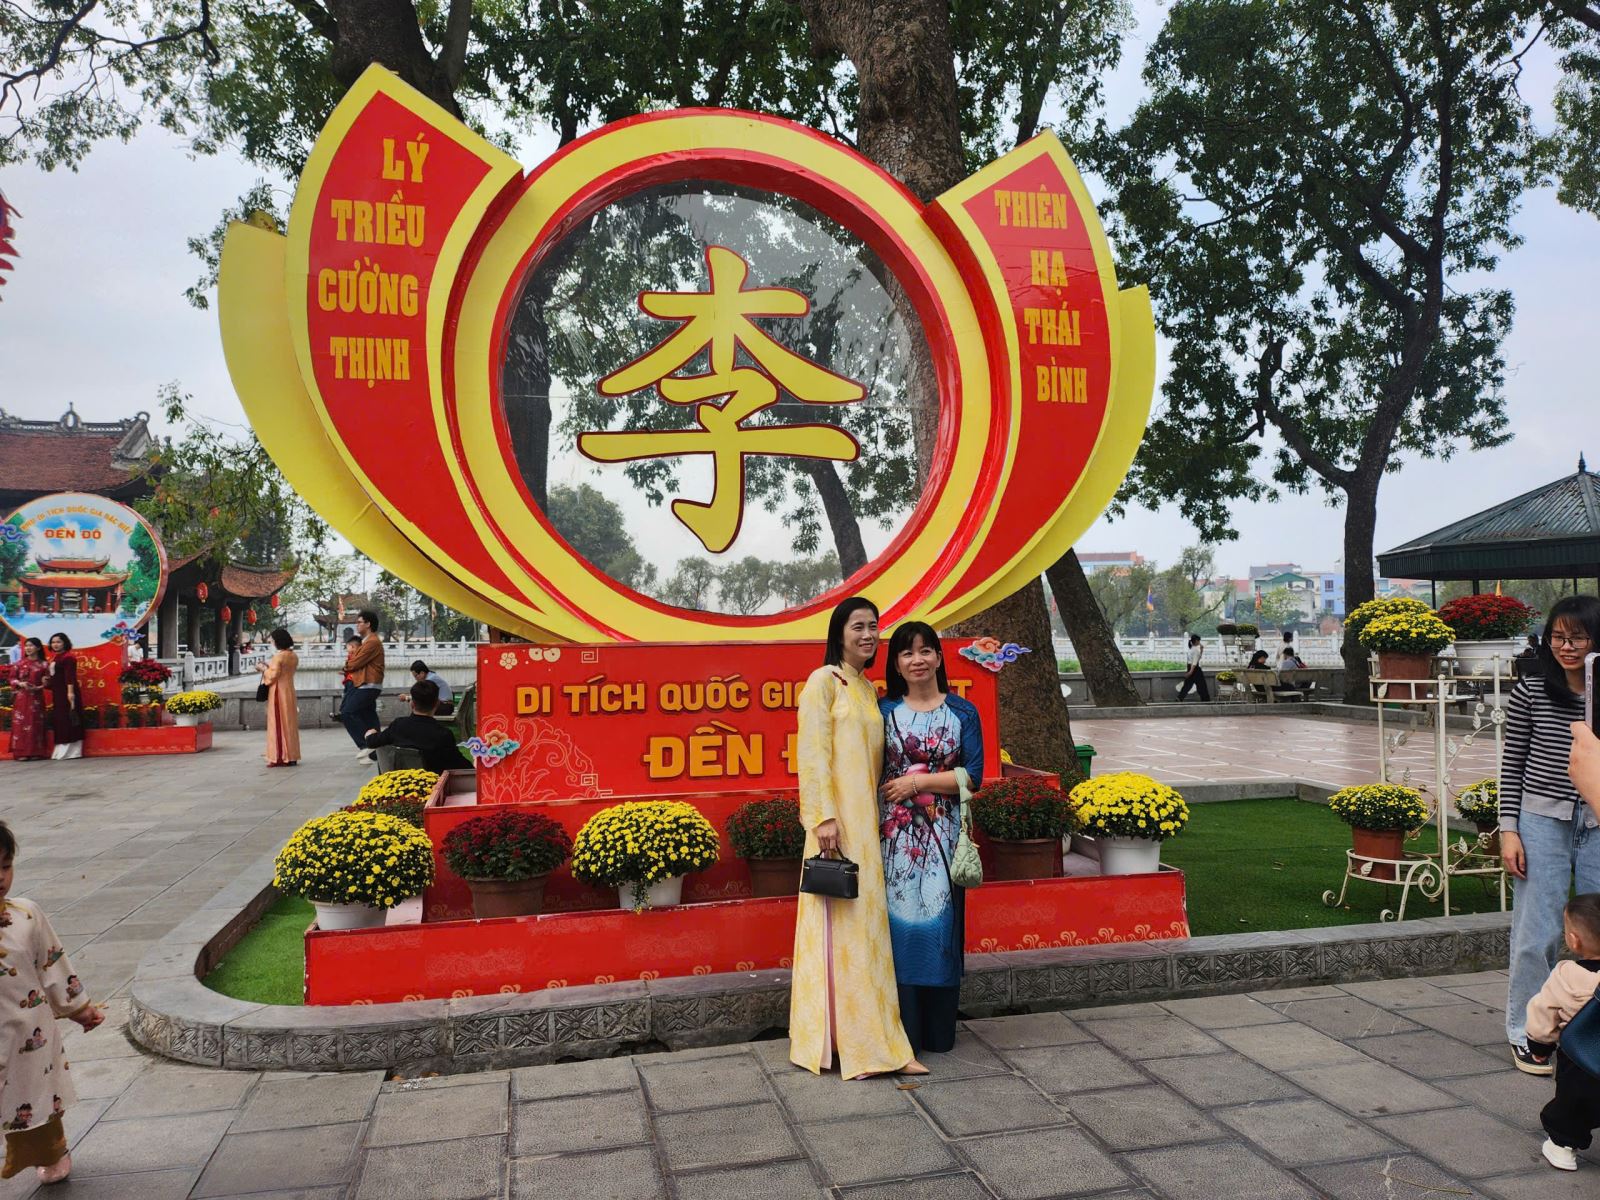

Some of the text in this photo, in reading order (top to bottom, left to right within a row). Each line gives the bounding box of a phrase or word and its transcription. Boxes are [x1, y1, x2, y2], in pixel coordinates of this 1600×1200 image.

[382, 132, 430, 183] LÝ
[331, 190, 425, 247] TRIỀU
[994, 184, 1068, 229] THIÊN
[318, 257, 419, 317] CƯỜNG
[1030, 250, 1068, 296] HẠ
[1024, 302, 1081, 346] THÁI
[330, 336, 410, 388] THỊNH
[1036, 357, 1088, 403] BÌNH
[577, 245, 867, 553] 李
[517, 685, 551, 714] DI
[563, 675, 645, 713] TÍCH
[660, 674, 749, 712] QUỐC
[644, 720, 763, 778] ĐỀN
